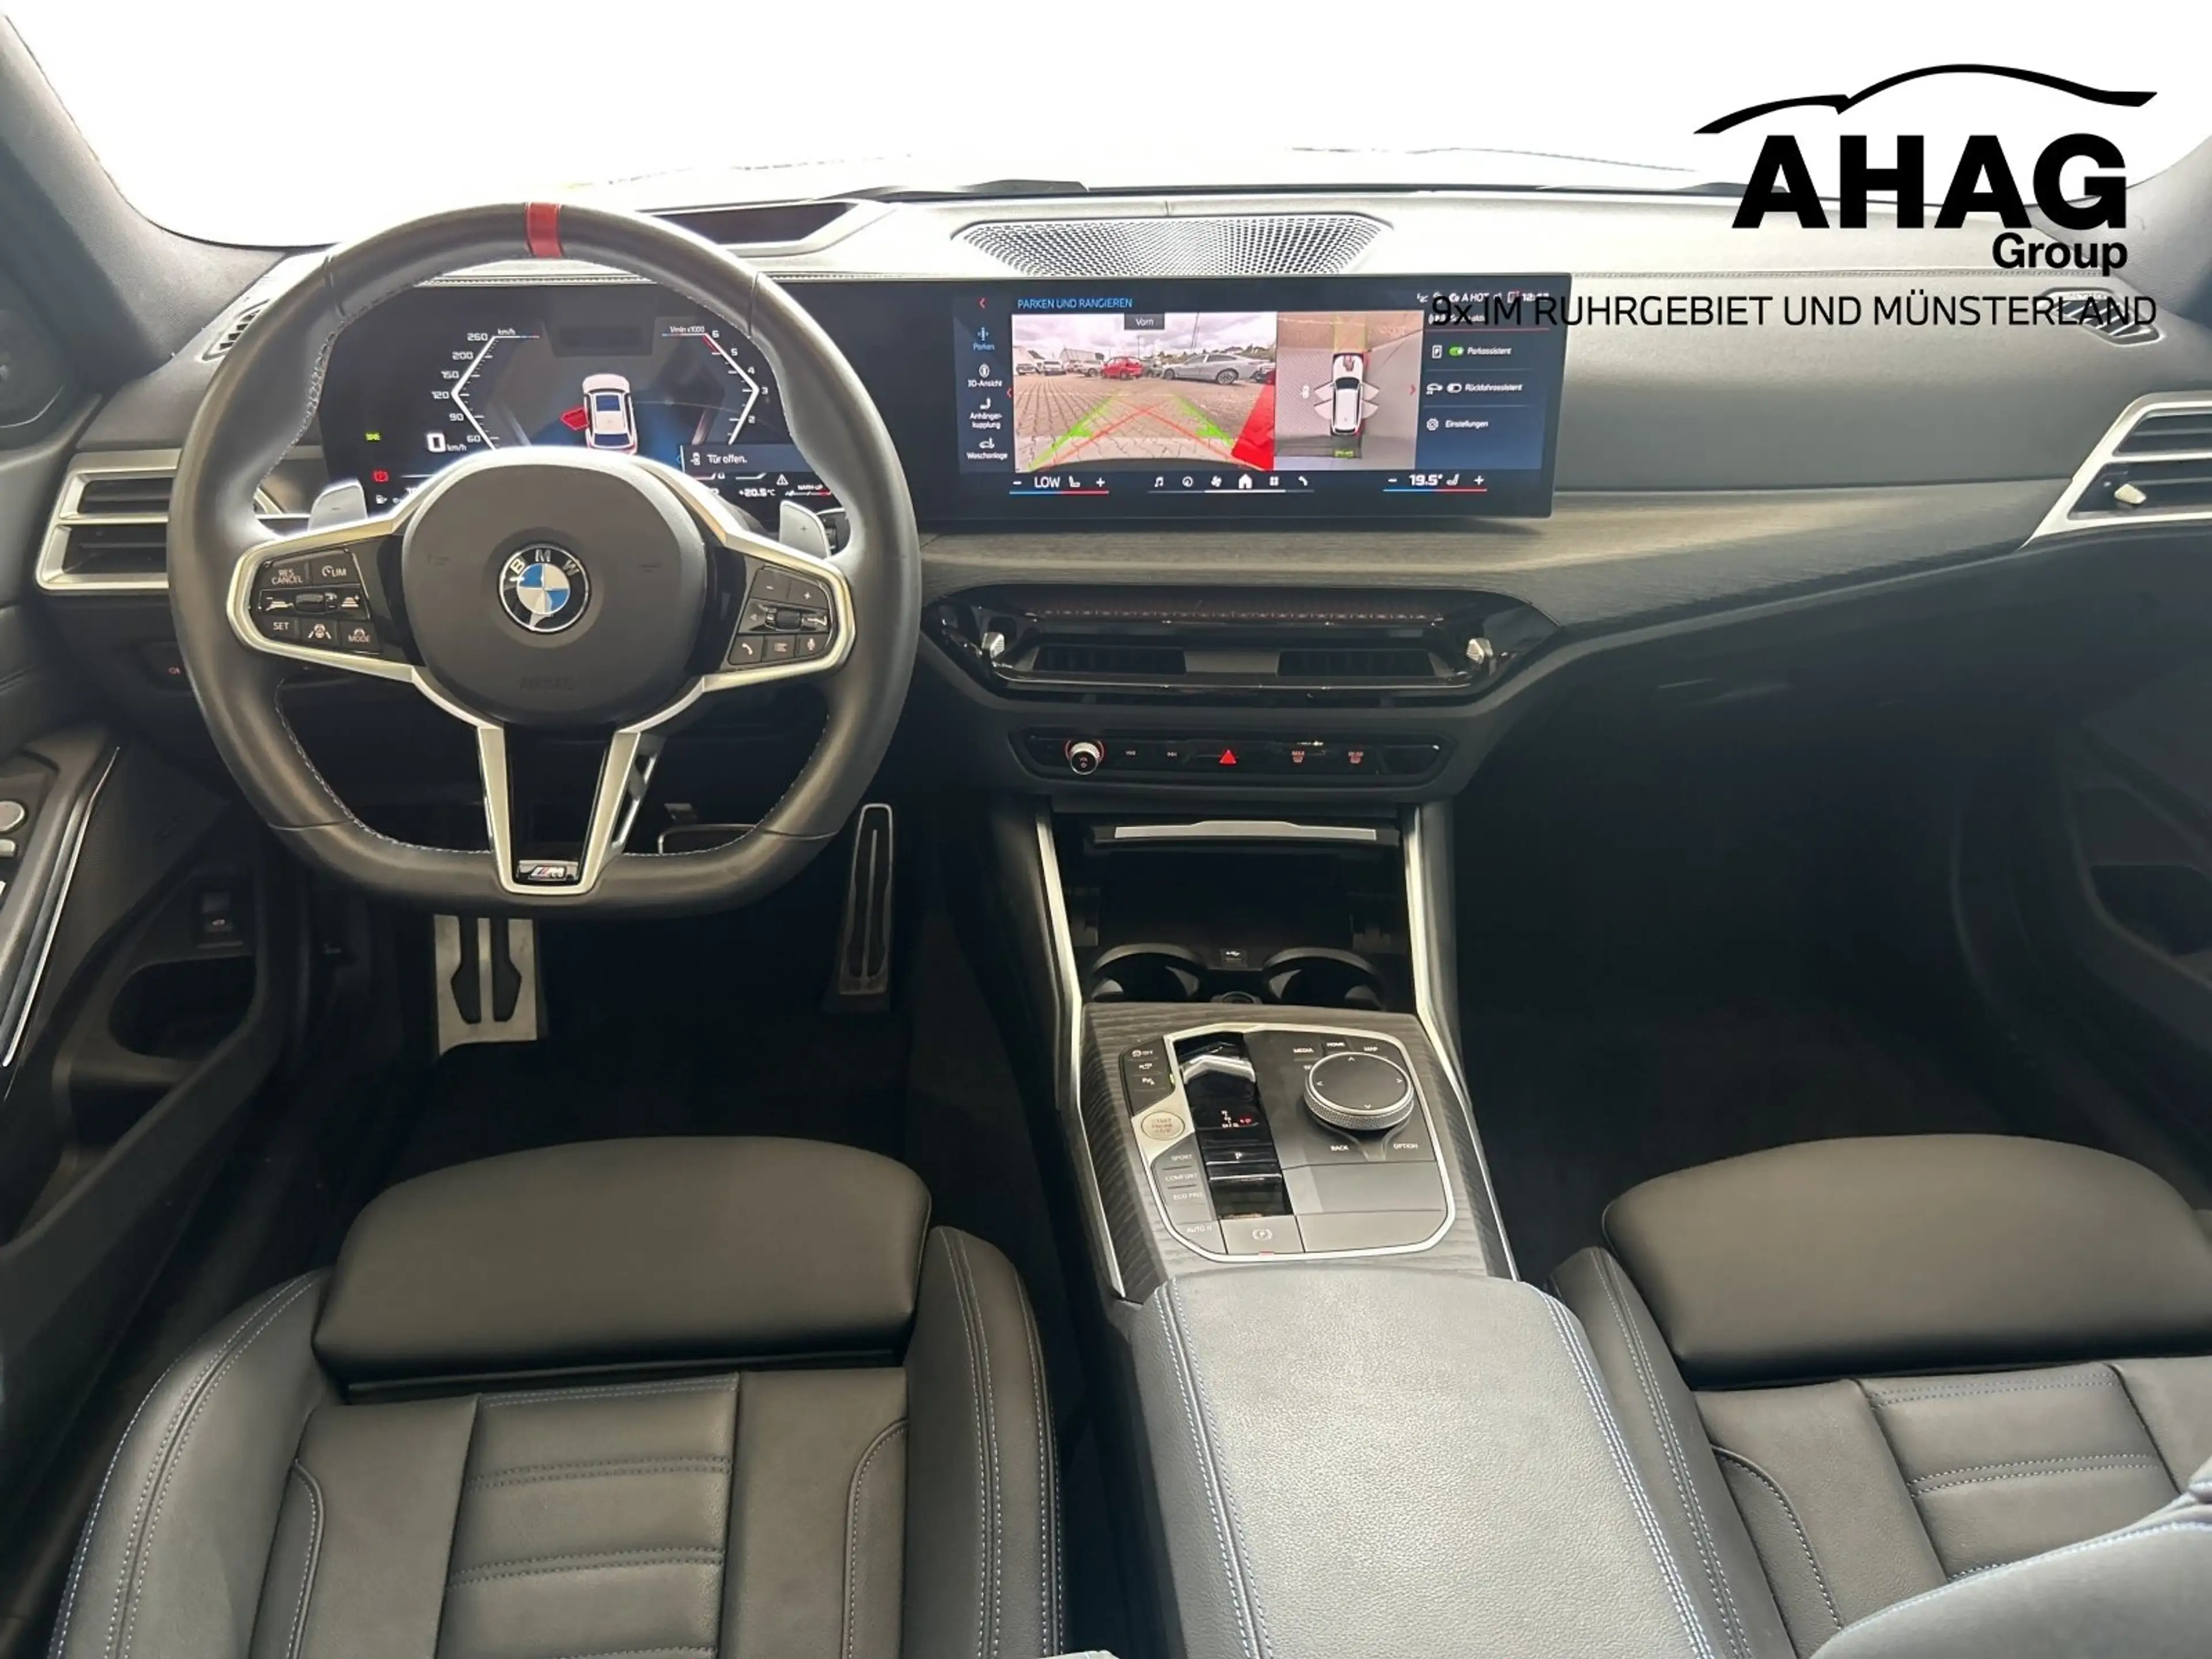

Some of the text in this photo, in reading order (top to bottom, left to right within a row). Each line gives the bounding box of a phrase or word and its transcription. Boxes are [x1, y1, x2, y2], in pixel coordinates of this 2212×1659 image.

[1017, 298, 1132, 309] PARKEN UND RANGIEREN
[1135, 317, 1154, 326] Vorn
[711, 330, 719, 339] 6
[972, 343, 995, 351] Parken
[1467, 347, 1513, 355] Parkassistent
[452, 351, 474, 360] 200
[730, 348, 738, 357] 5
[747, 366, 756, 374] 4
[441, 370, 460, 380] 150
[431, 391, 450, 399] 120
[761, 387, 769, 395] 3
[449, 413, 464, 421] 90
[748, 415, 756, 424] 2
[1445, 419, 1489, 430] Einstellungen
[426, 432, 467, 453] 0 km/h
[707, 453, 748, 465] Tür offen.
[1034, 476, 1060, 488] LOW
[510, 549, 579, 576] BMW
[271, 576, 304, 585] CANCEL
[273, 621, 290, 630] SET
